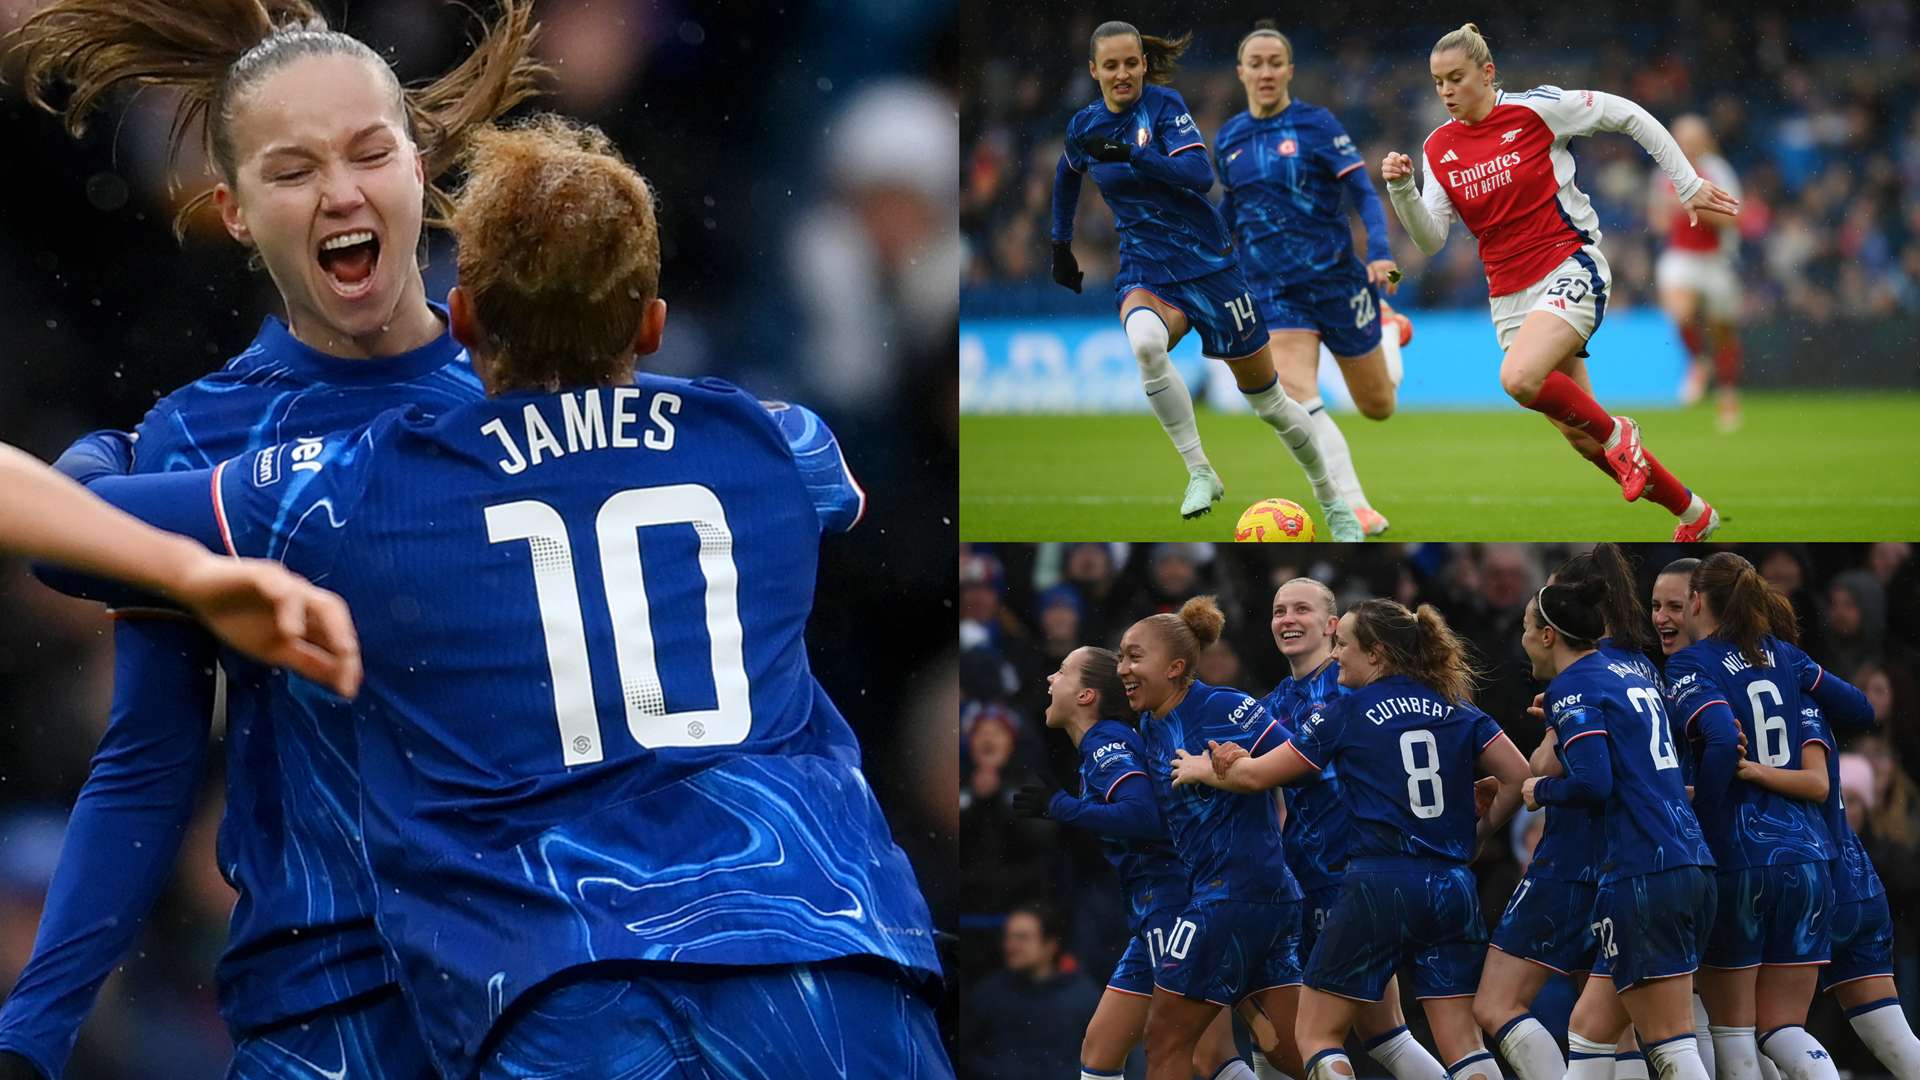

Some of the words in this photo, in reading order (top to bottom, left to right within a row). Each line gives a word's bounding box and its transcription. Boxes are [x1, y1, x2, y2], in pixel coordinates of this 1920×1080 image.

[1448, 151, 1521, 188] Emirates
[1465, 182, 1479, 201] FLY
[1481, 169, 1513, 195] BETTER
[1224, 292, 1257, 332] 14
[1351, 287, 1376, 330] 22
[1547, 277, 1589, 304] 23
[480, 387, 682, 475] JAMES
[484, 483, 752, 766] 10
[1746, 679, 1790, 768] 6
[1093, 741, 1127, 763] fever
[1400, 729, 1445, 819] 8
[1165, 916, 1197, 960] 10
